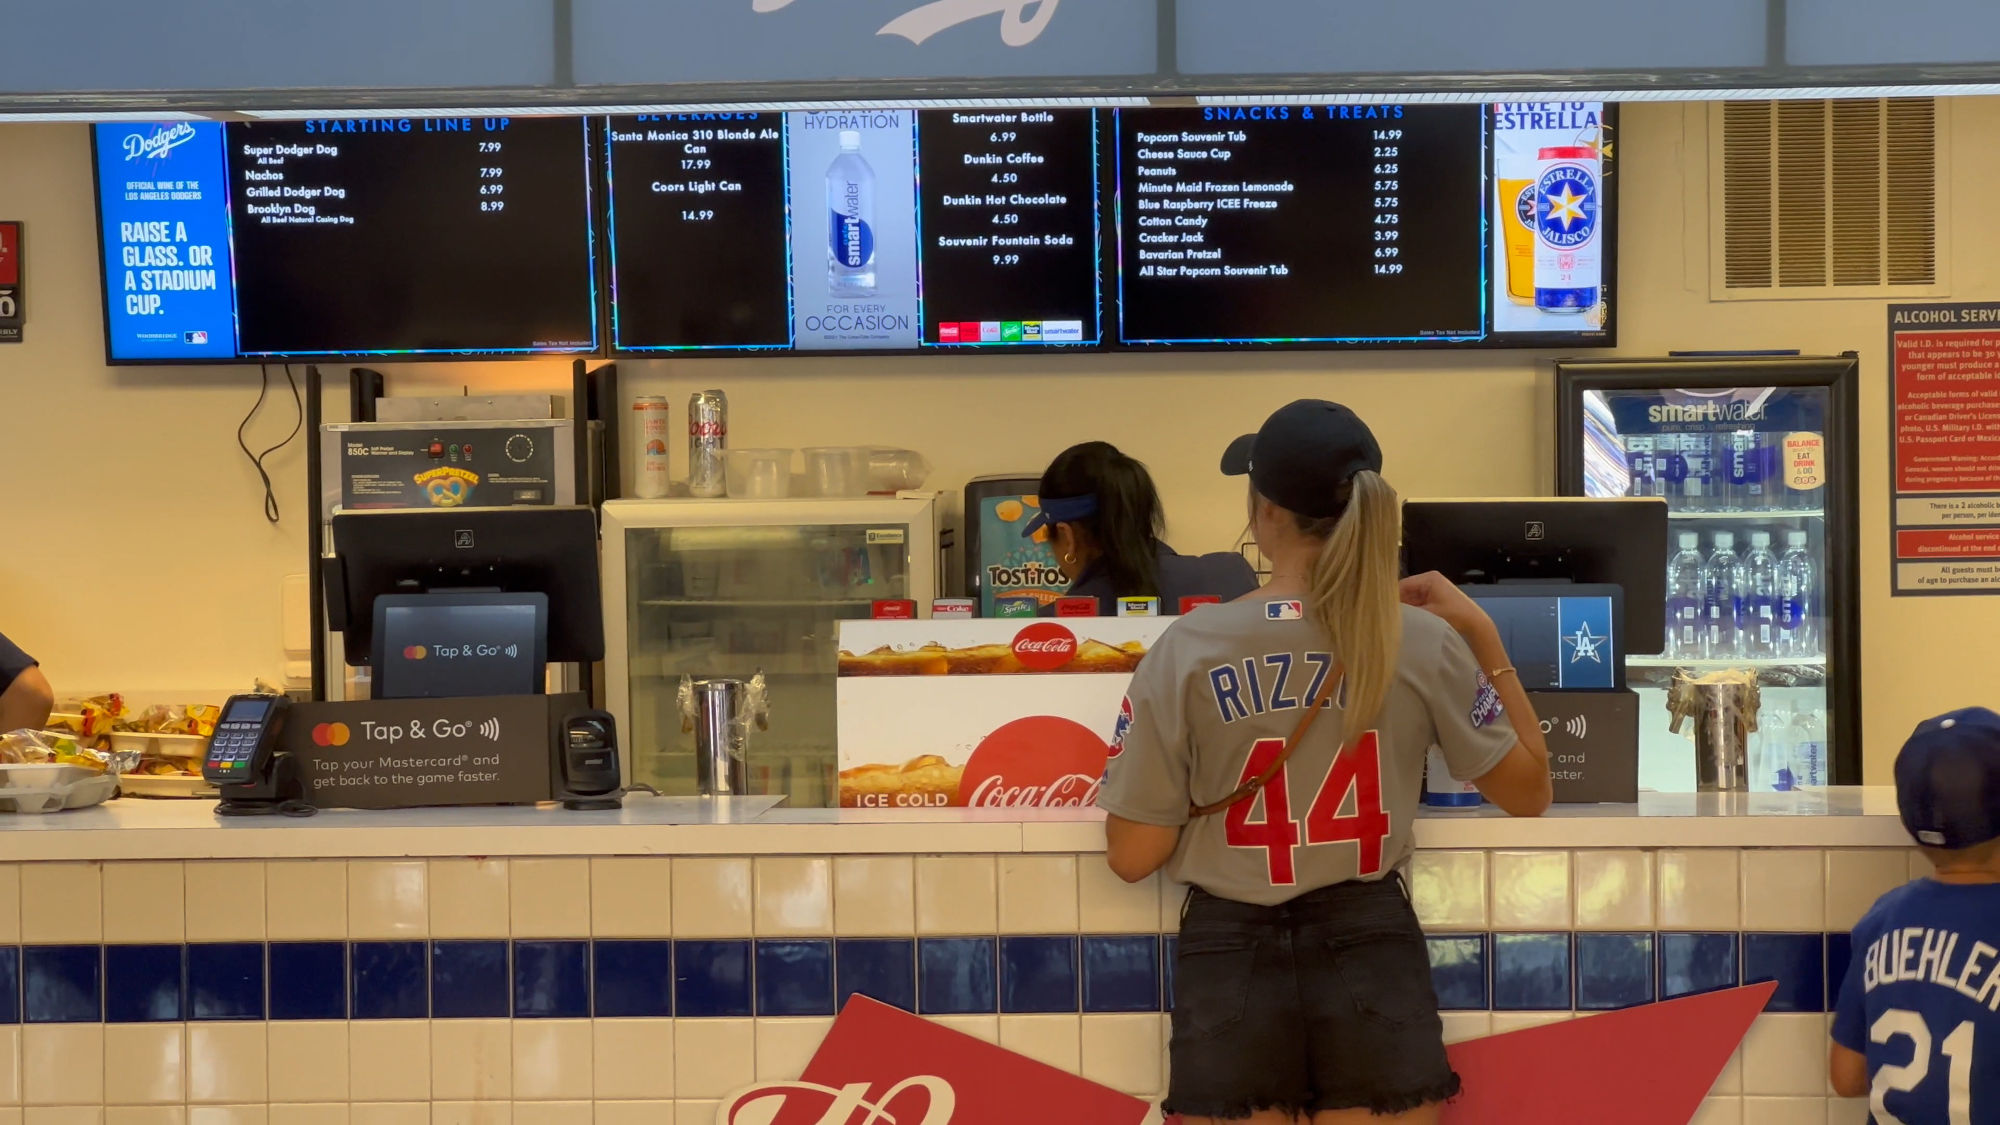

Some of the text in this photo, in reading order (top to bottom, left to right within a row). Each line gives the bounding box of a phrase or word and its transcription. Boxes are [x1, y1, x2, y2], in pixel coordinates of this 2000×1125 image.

[637, 112, 759, 122] BEVERAGES
[952, 111, 1054, 123] Smartwater Bottle
[1204, 105, 1404, 120] SNACKS & TREATS
[305, 117, 510, 133] STARTING LINE UP
[804, 114, 899, 130] HYDRATION
[611, 128, 779, 141] Santa Monica 310 Blonde Ale
[990, 132, 1017, 142] 6.99
[1137, 131, 1247, 144] Popcorn Souvenir Tub
[1373, 130, 1402, 140] 14.99
[122, 121, 196, 161] Dodgers
[243, 143, 338, 157] Super Dodger Dog
[479, 142, 502, 153] 7.99
[684, 144, 707, 154] Can
[1374, 147, 1398, 157] 2.25
[964, 152, 1044, 164] Dunkin Coffee
[1137, 148, 1231, 161] Cheese Sauce Cup
[681, 159, 711, 170] 17.99
[1374, 164, 1398, 174] 6.25
[245, 169, 284, 180] Nachos
[480, 167, 502, 178] 7.99
[1137, 166, 1177, 176] Peanuts
[990, 173, 1018, 183] 4.50
[1539, 168, 1594, 196] ESTRELLA
[126, 181, 155, 190] OFFICIAL
[176, 181, 184, 190] OF
[186, 181, 199, 190] THE
[480, 184, 504, 195] 6.99
[651, 180, 742, 194] Coors Light Can
[1138, 181, 1294, 193] Minute Maid Frozen Lemonade
[1374, 180, 1398, 190] 5.75
[125, 191, 139, 200] LOS
[140, 191, 169, 200] ANGELES
[246, 186, 346, 199] Grilled Dodger Dog
[943, 193, 1067, 205] Dunkin Hot Chocolate
[1138, 198, 1278, 211] Blue Raspberry ICEE Freeze
[1374, 197, 1398, 207] 5.75
[247, 203, 316, 216] Brooklyn Dog
[481, 201, 504, 211] 8.99
[681, 211, 714, 221] 14.99
[991, 214, 1019, 224] 4.50
[1138, 215, 1208, 228] Cotton Candy
[1374, 214, 1398, 224] 4.75
[846, 181, 861, 268] smartwater
[120, 221, 188, 243] RAISE A
[1138, 232, 1204, 243] Cracker Jack
[1374, 231, 1398, 241] 3.99
[1542, 226, 1591, 245] JALISCO
[938, 234, 1073, 247] Souvenir Fountain Soda
[122, 245, 213, 267] GLASS. OR
[1139, 248, 1222, 260] Bavarian Pretzel
[1374, 247, 1398, 257] 6.99
[992, 254, 1020, 265] 9.99
[1139, 264, 1289, 278] All Star Popcorn Souvenir Tub
[1373, 264, 1403, 274] 14.99
[124, 269, 217, 291] A STADIUM
[126, 293, 165, 315] CUP.
[826, 303, 886, 314] FOR EVERY
[805, 314, 909, 331] OCCASION
[1894, 310, 1958, 324] ALCOHOL
[1897, 339, 1918, 348] Valid
[1936, 339, 1944, 347] is
[1945, 338, 1980, 349] required
[1982, 338, 1993, 347] for
[1786, 439, 1820, 448] BALANCE
[347, 447, 370, 456] 850C
[1797, 452, 1811, 460] EAT
[1793, 459, 1815, 467] DRINK
[987, 562, 1071, 587] TOSTITOS
[433, 644, 459, 659] Tap
[462, 644, 473, 656] &
[1014, 637, 1073, 655] Coca-Cola
[1208, 651, 1348, 724] RIZZ
[1470, 689, 1500, 728] CHAMP
[360, 720, 403, 744] Tap
[410, 719, 427, 739] &
[313, 758, 340, 774] Tap
[343, 760, 375, 771] your
[473, 753, 500, 766] and
[1557, 751, 1586, 764] and
[313, 770, 501, 789] get back to the game faster.
[1550, 768, 1586, 781] aster.
[856, 793, 948, 808] ICE COLD
[1224, 729, 1391, 886] 44
[1869, 1008, 1976, 1125] 21
